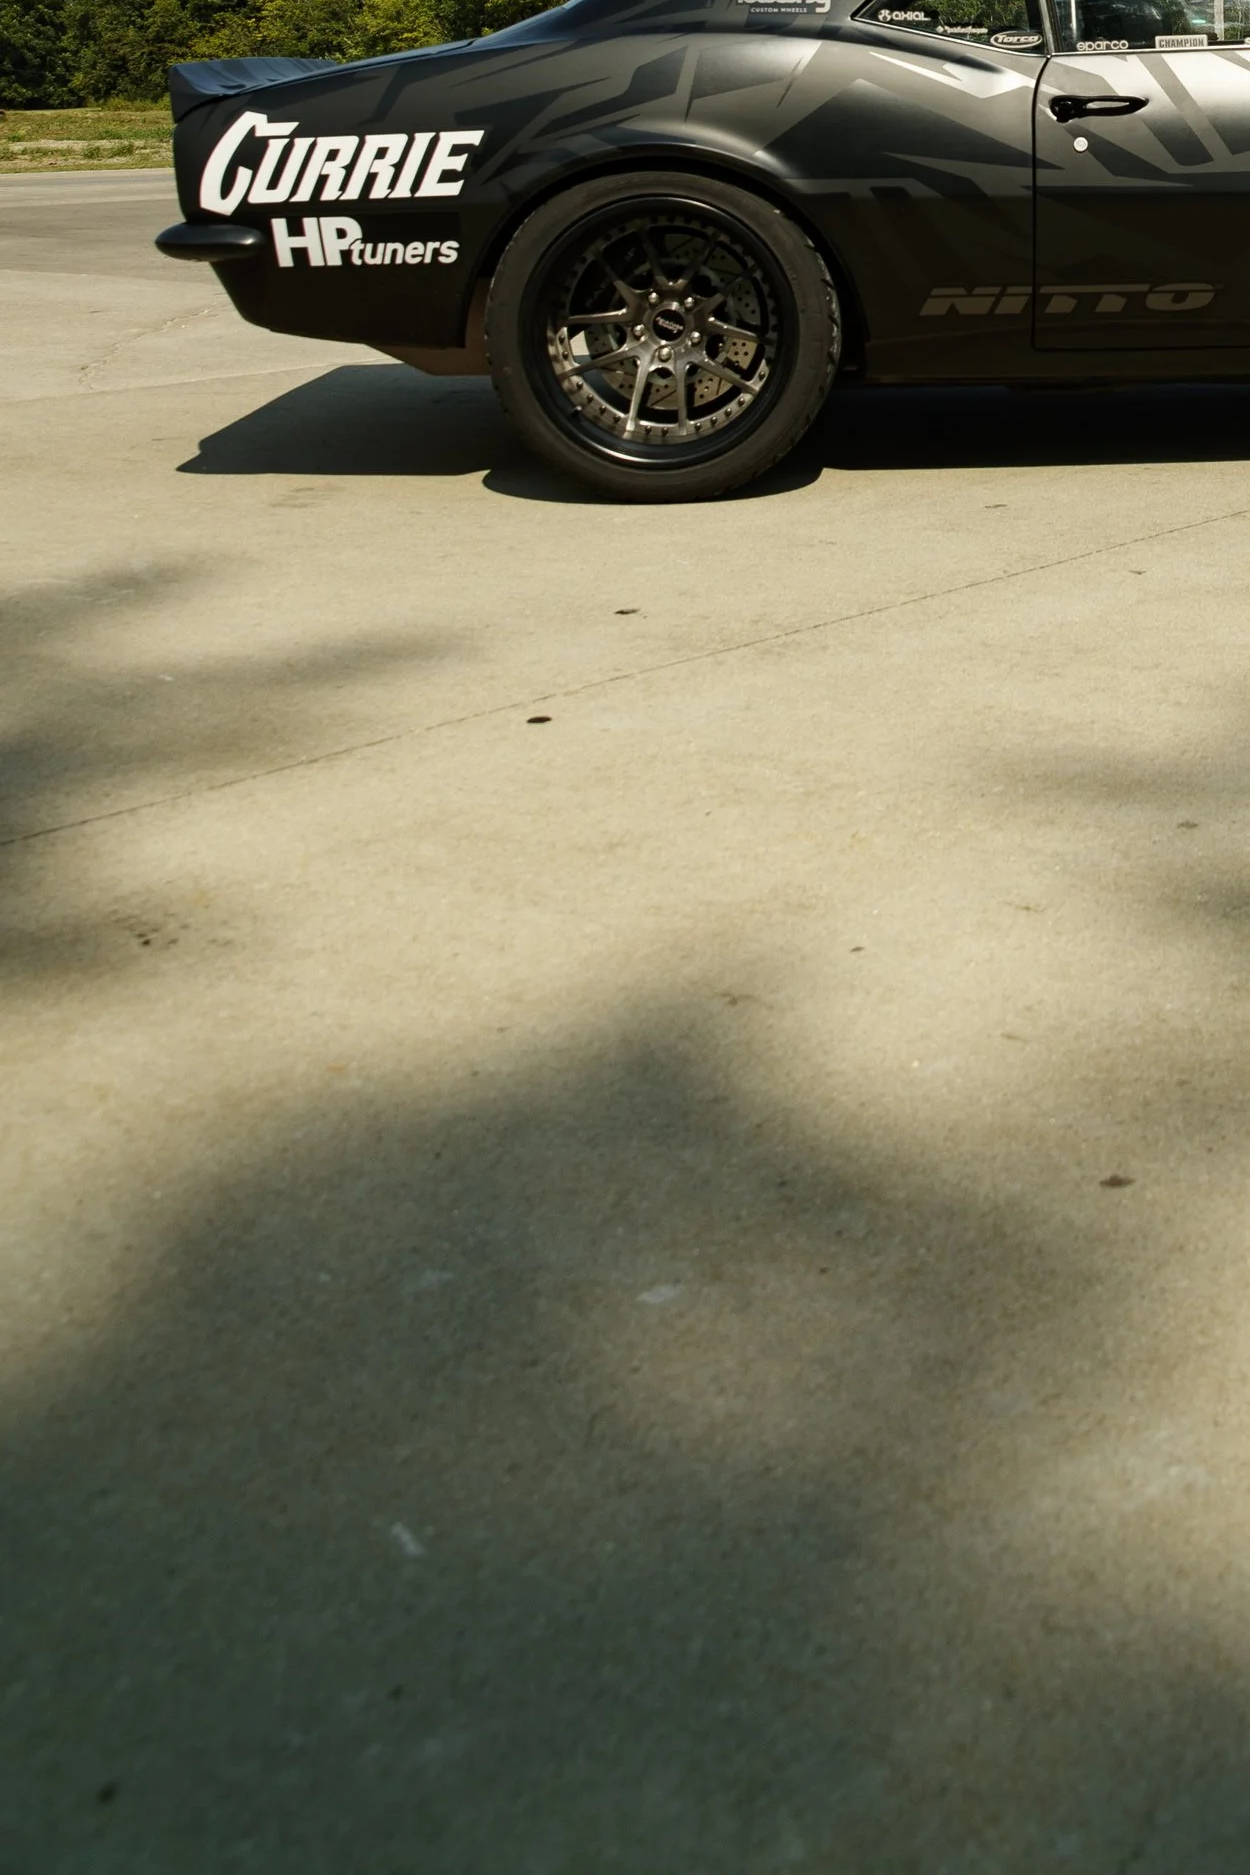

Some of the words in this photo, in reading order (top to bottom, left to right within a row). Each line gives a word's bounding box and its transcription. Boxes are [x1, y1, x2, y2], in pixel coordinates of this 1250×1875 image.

[1076, 40, 1129, 51] sparco
[1158, 38, 1204, 48] CHAMPION
[199, 111, 485, 216] CURRIE
[919, 283, 1216, 315] NITTO
